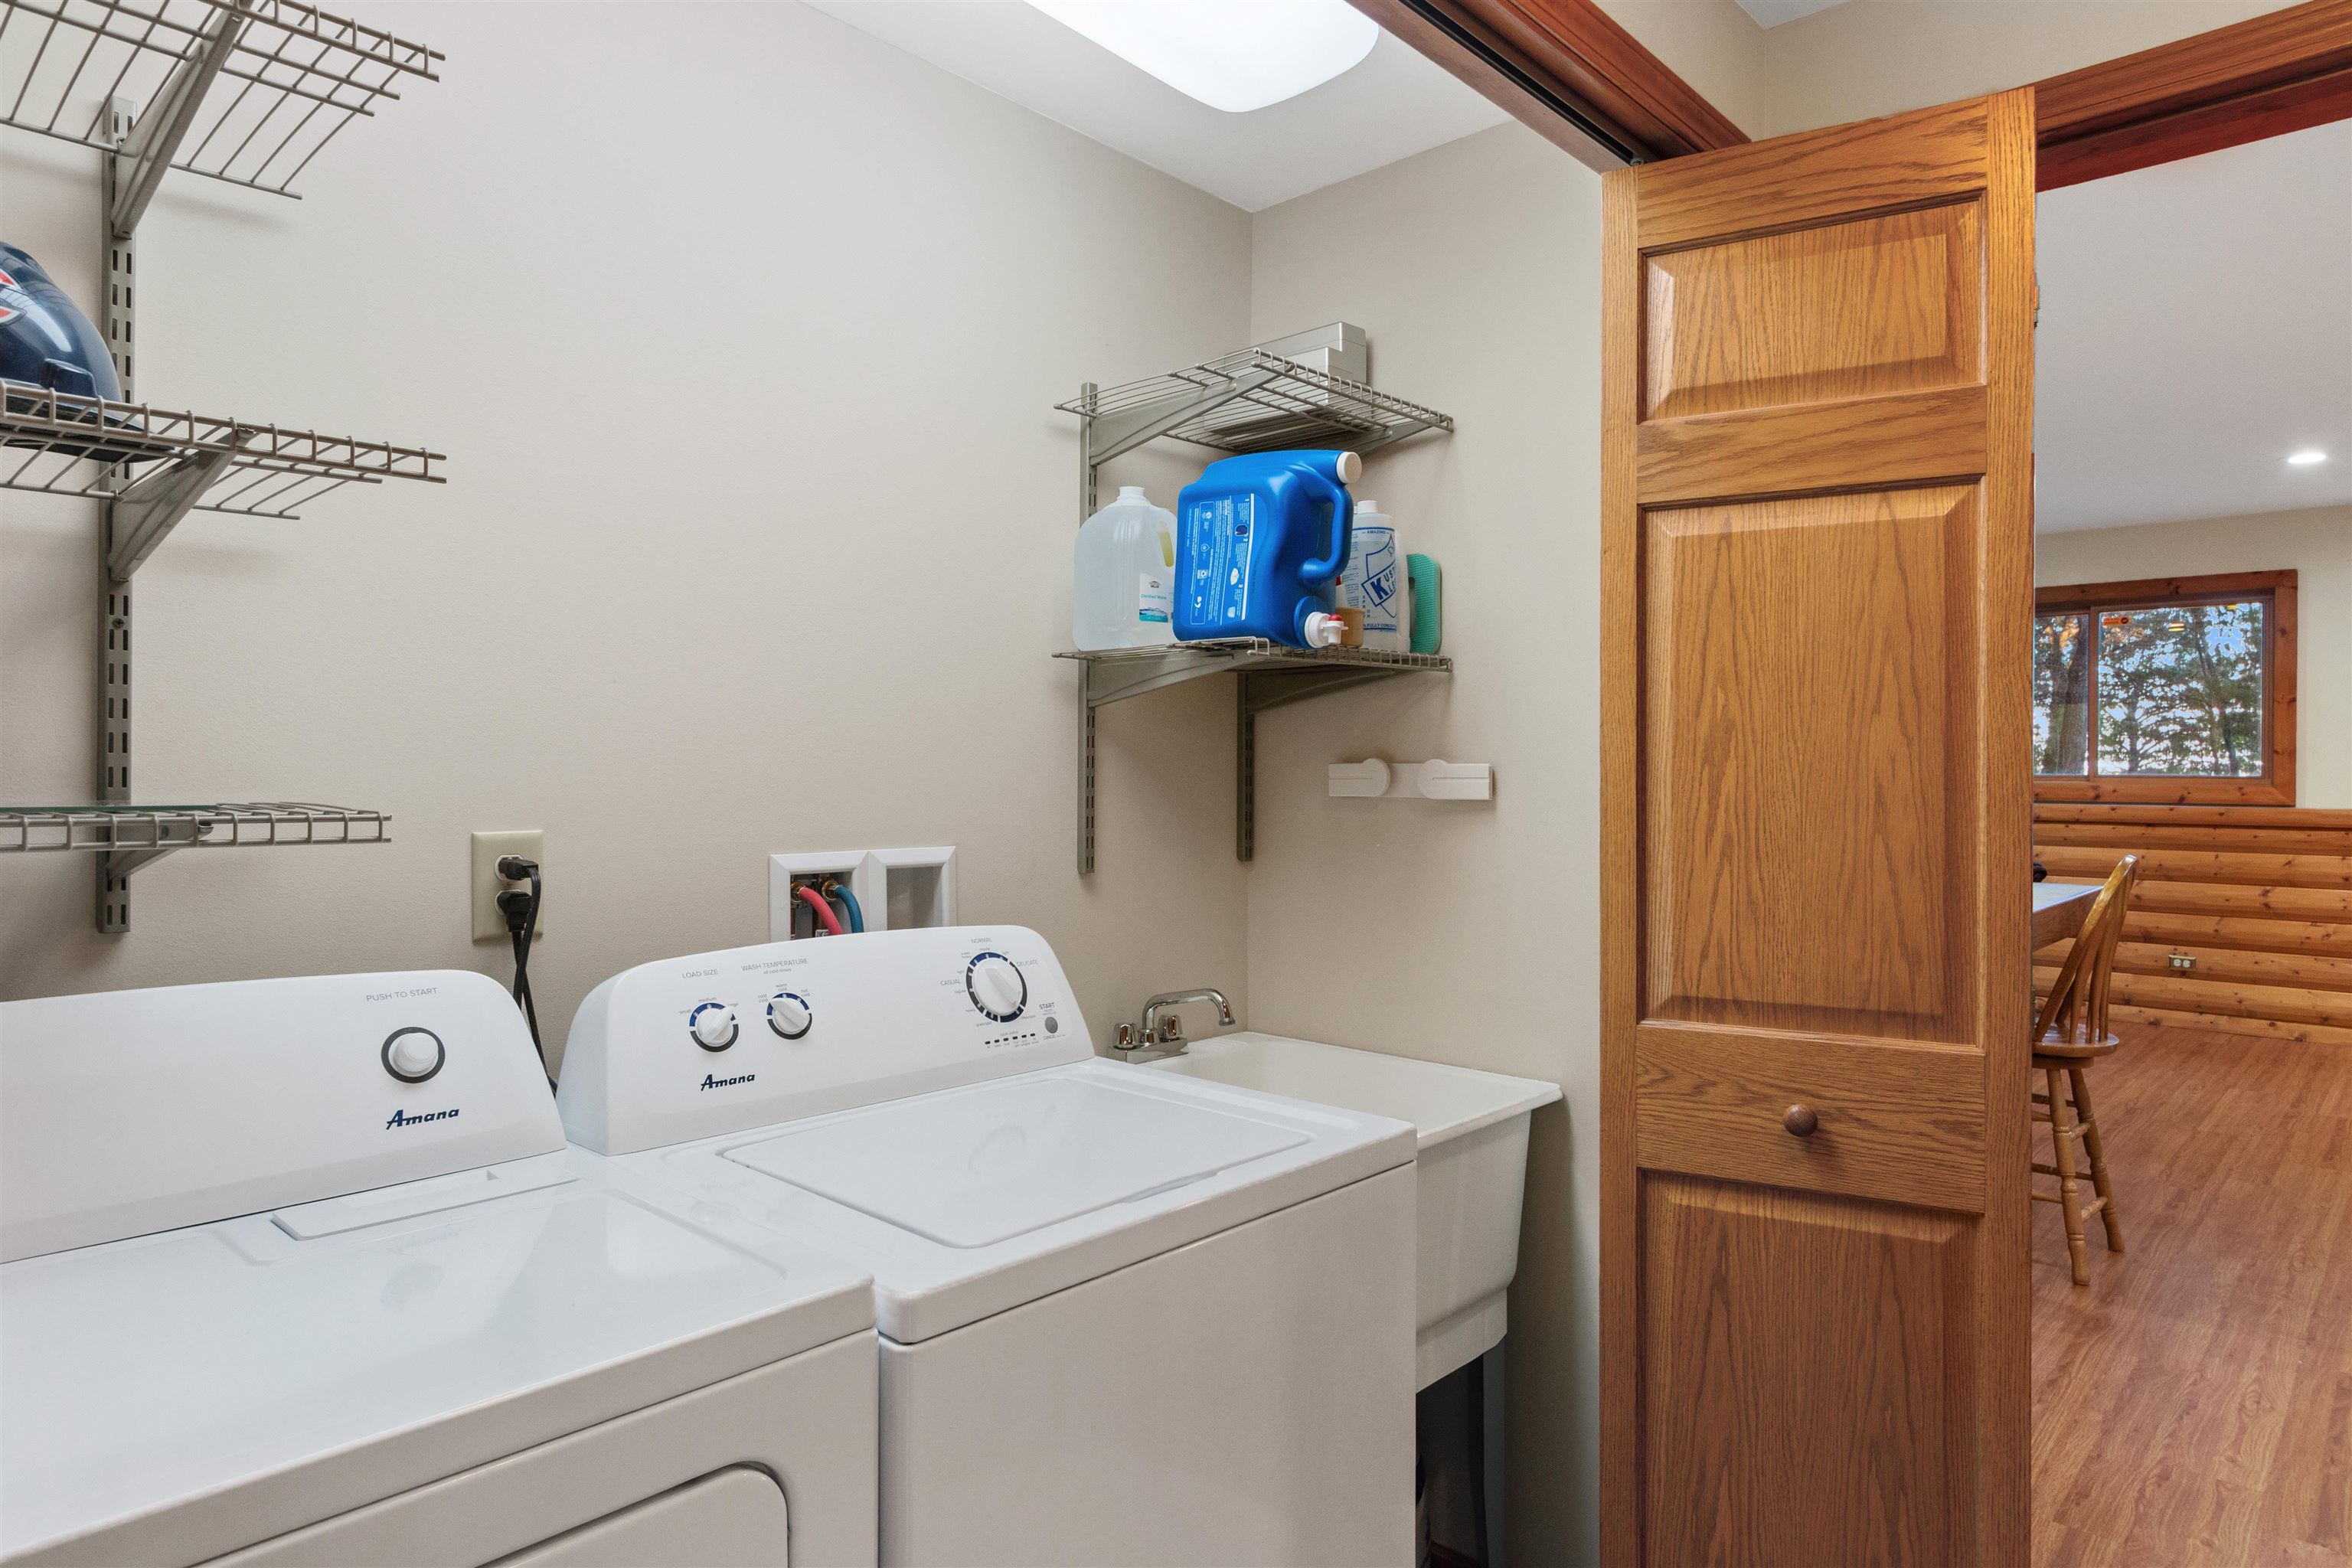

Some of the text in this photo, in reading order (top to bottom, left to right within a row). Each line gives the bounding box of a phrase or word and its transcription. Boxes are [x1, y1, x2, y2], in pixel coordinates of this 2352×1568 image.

[741, 958, 808, 972] WASH TEMPERATURE
[682, 971, 702, 979] LOAD
[366, 993, 393, 1002] PUSH
[409, 987, 438, 997] START
[701, 1073, 756, 1092] Amana
[386, 1109, 460, 1131] Amana
